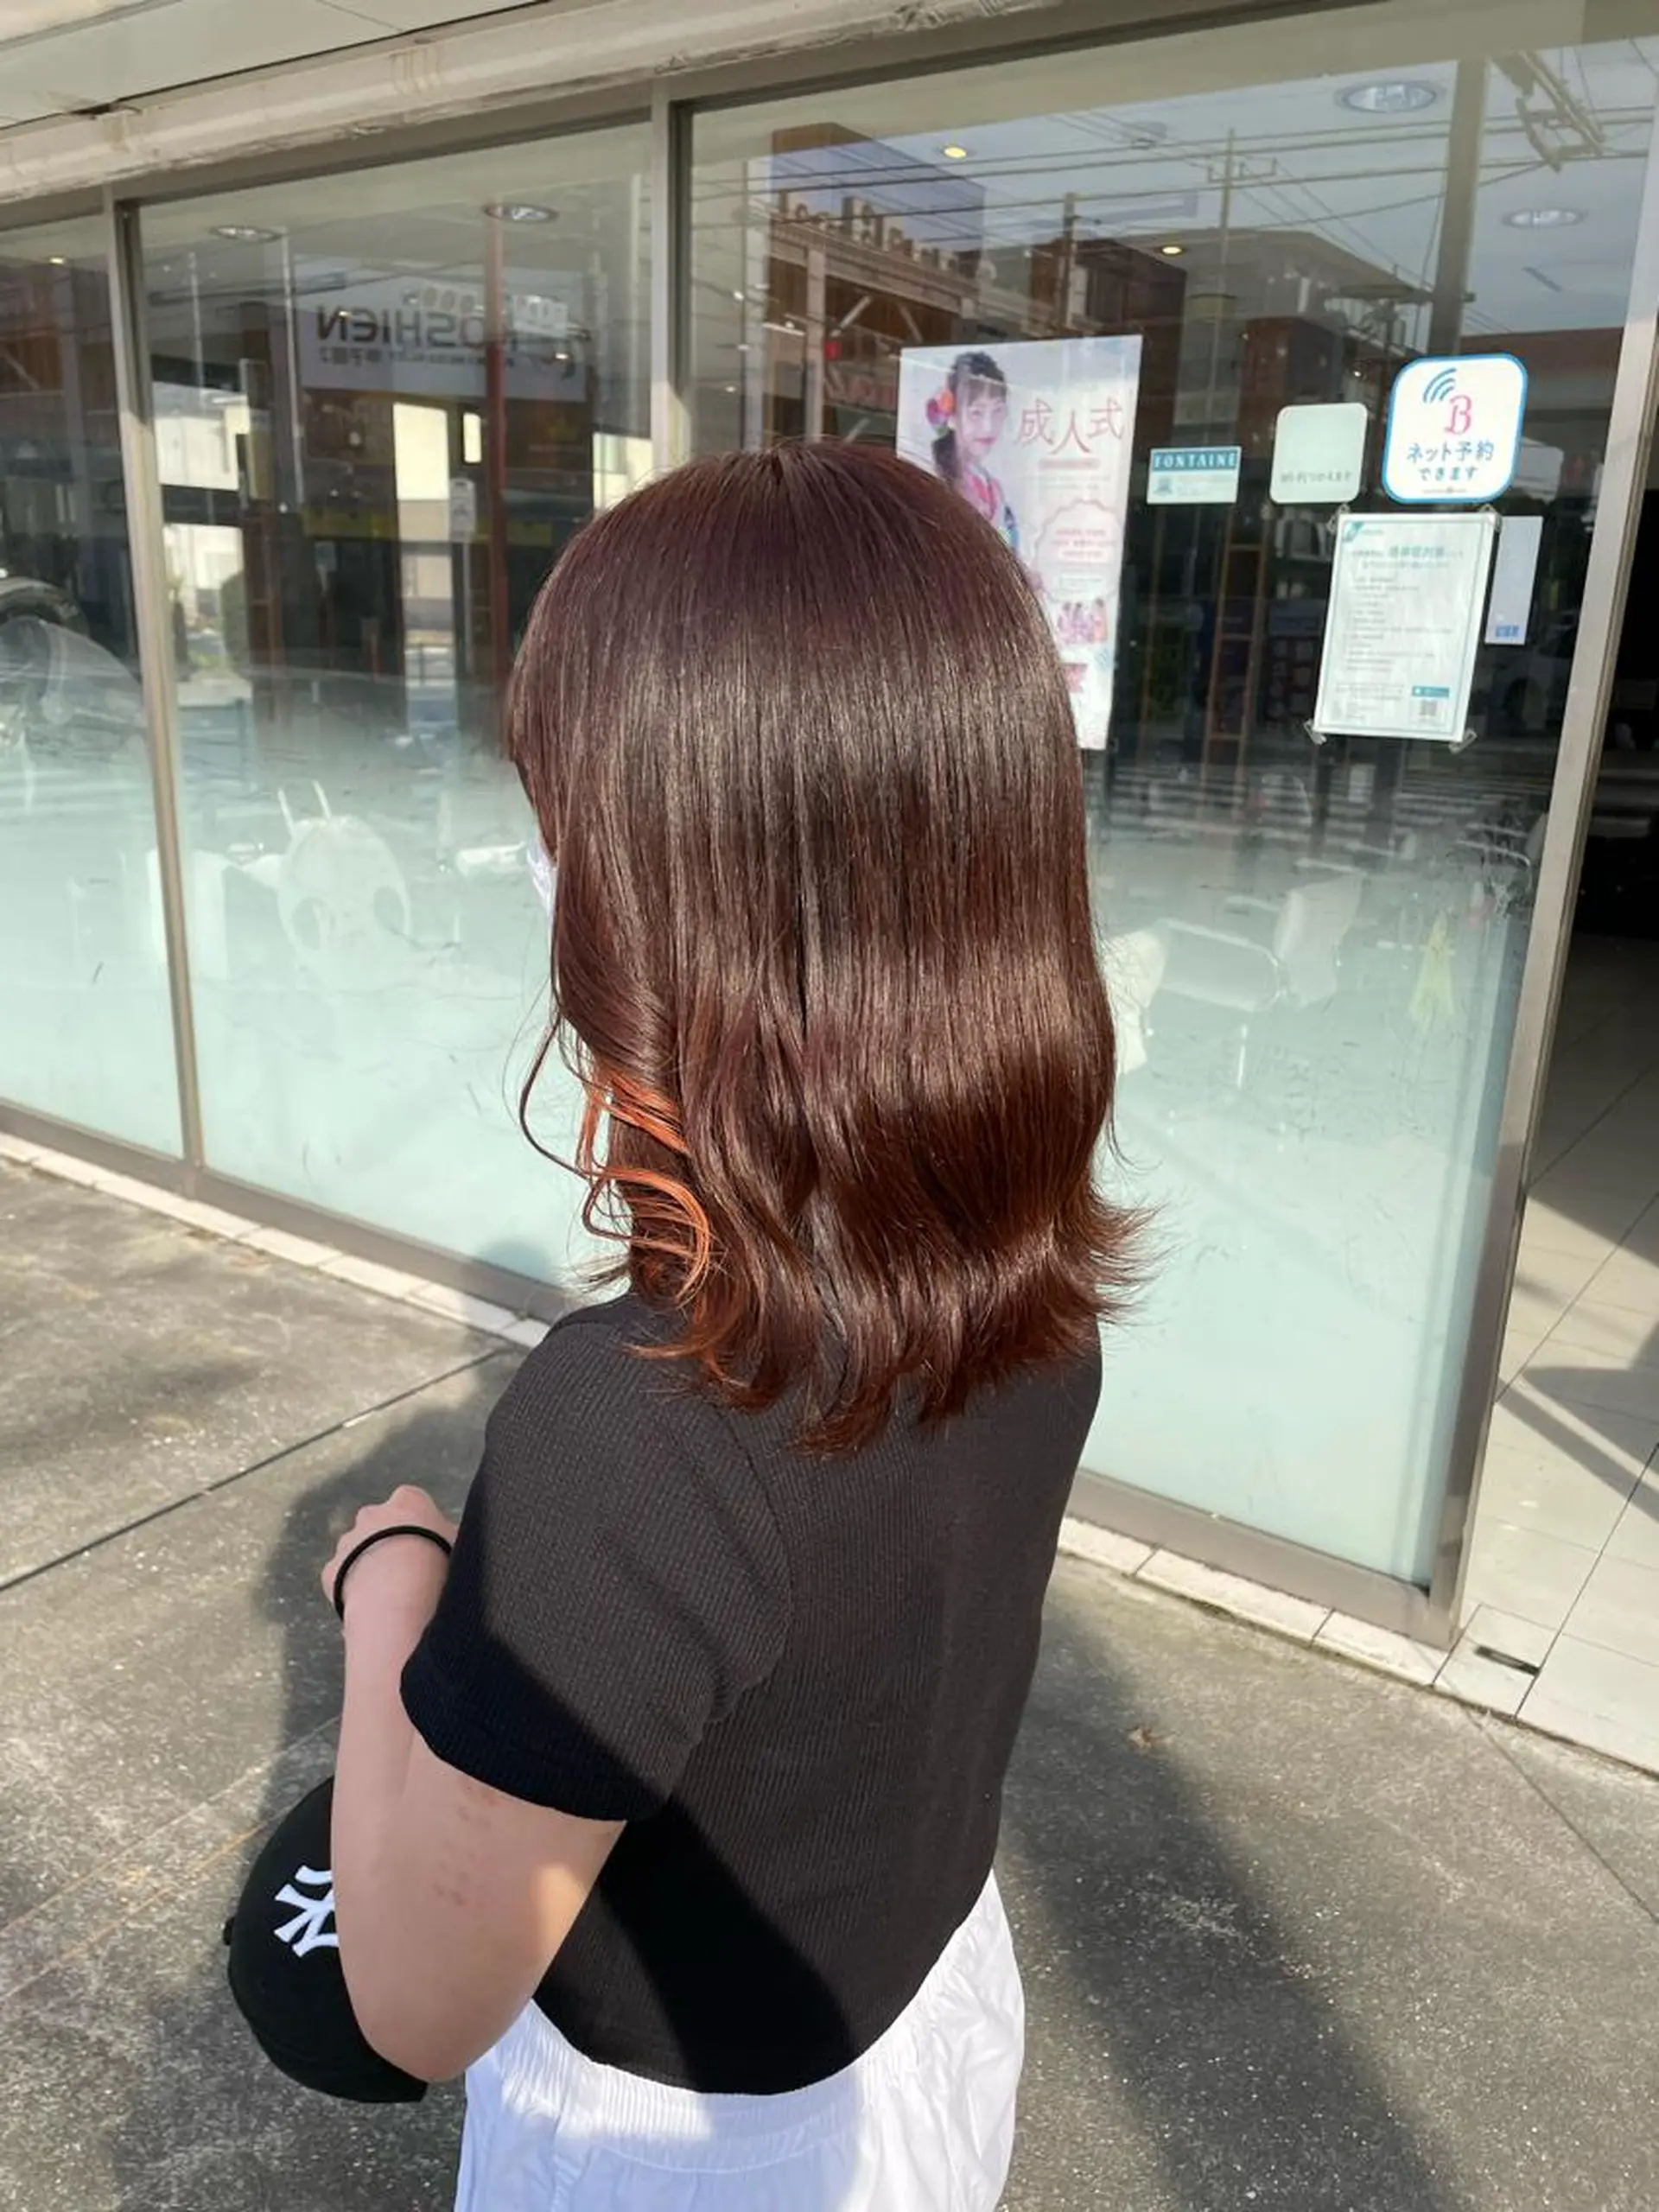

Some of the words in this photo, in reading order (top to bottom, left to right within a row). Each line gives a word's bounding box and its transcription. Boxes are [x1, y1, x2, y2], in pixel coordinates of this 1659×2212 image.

[1015, 397, 1124, 455] 成人式
[1444, 394, 1473, 435] B
[1154, 452, 1236, 469] FONTAINE
[1407, 441, 1496, 464] ネット予約
[1418, 466, 1478, 482] できます
